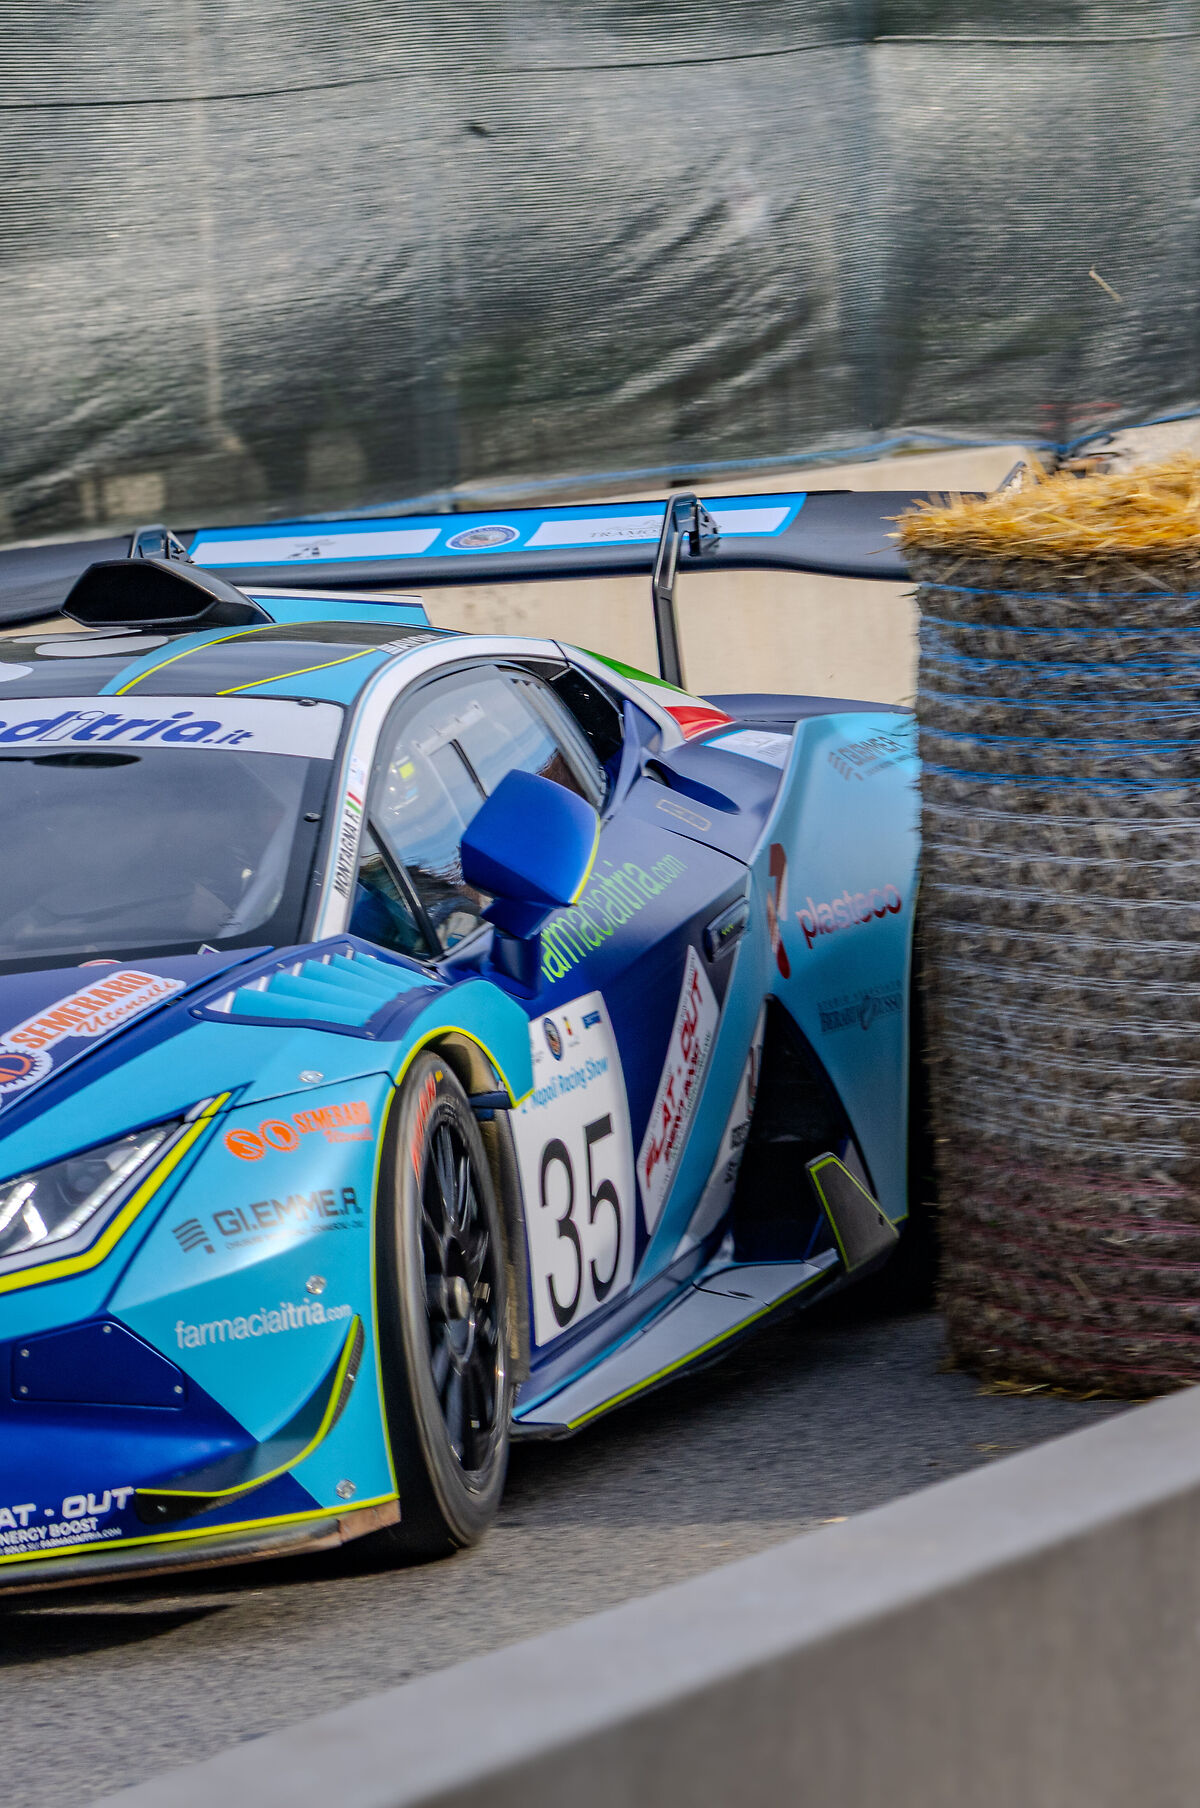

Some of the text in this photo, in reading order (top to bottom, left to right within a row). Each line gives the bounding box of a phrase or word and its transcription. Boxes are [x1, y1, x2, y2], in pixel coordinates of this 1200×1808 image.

[334, 822, 357, 900] MONTAGNA
[10, 973, 155, 1049] SEMERARO
[76, 979, 177, 1033] Utensili
[541, 1113, 622, 1328] 35
[175, 1298, 353, 1349] farmaciaitria.com
[49, 1516, 99, 1538] BOOST
